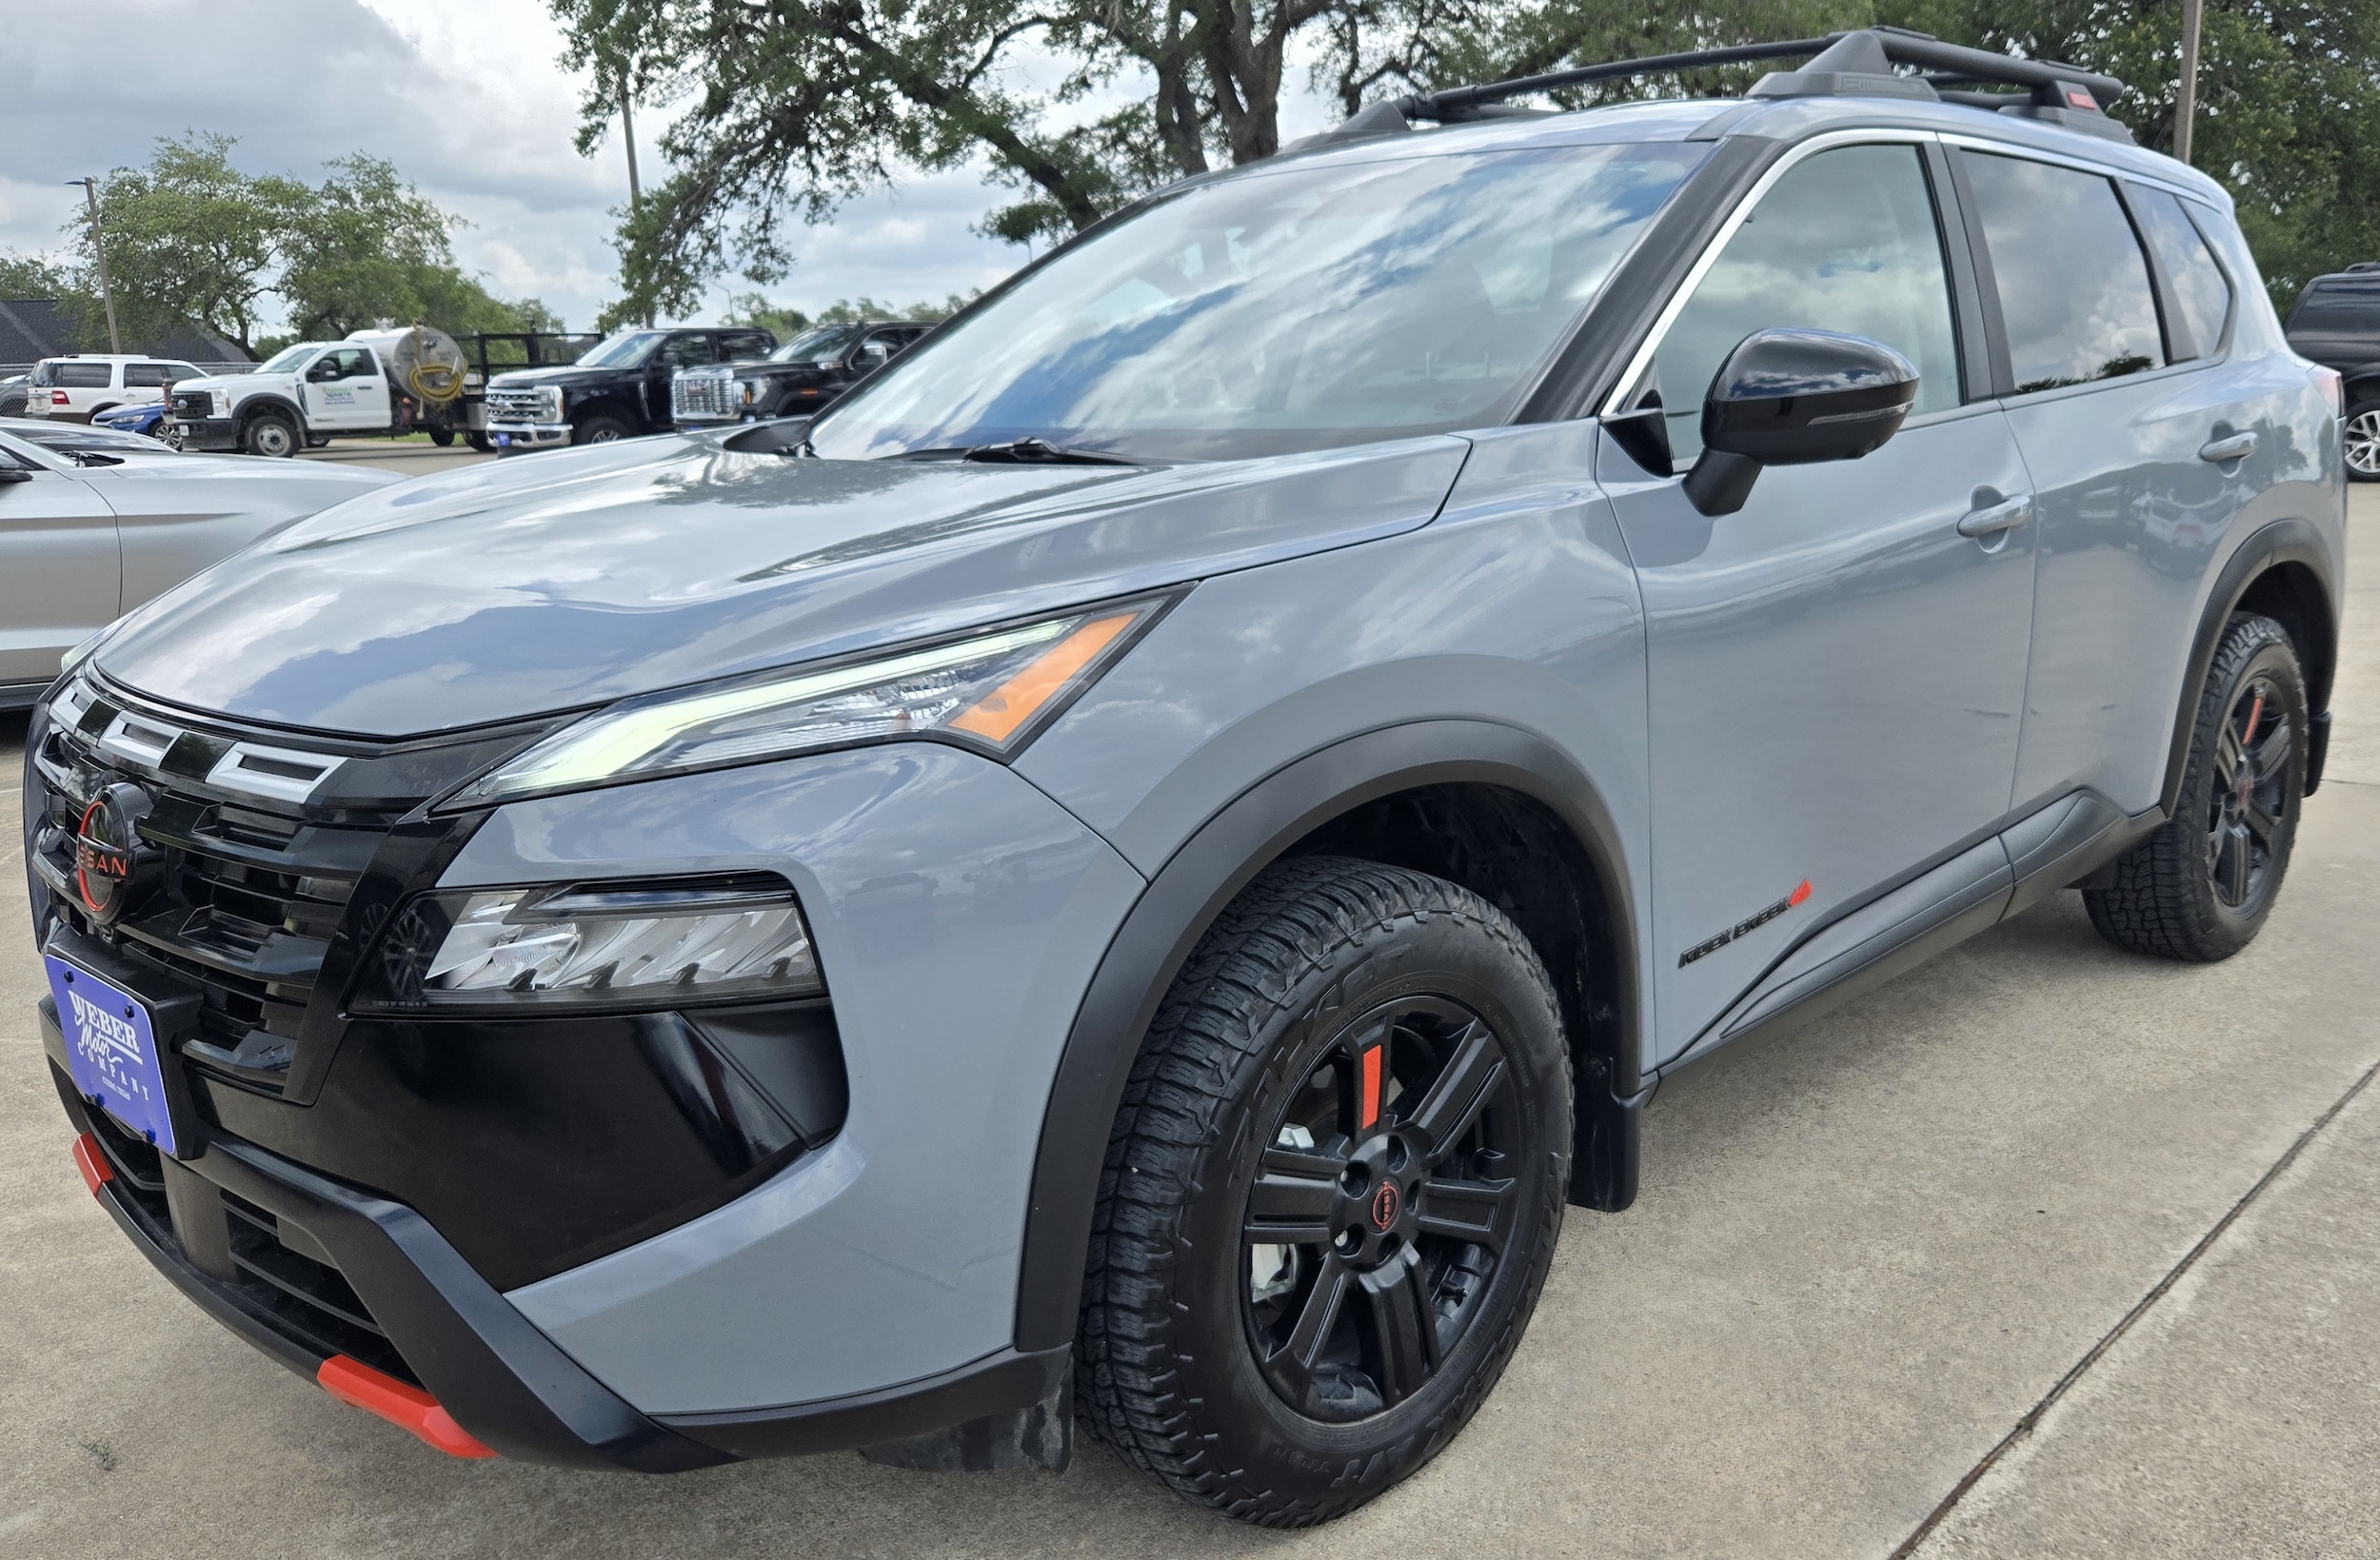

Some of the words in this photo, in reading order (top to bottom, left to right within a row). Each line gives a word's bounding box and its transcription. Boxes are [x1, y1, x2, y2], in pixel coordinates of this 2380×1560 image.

[79, 845, 127, 876] SSAN
[68, 989, 140, 1054] WEBER
[74, 1015, 123, 1064] Motor
[77, 1040, 150, 1101] COMPANY
